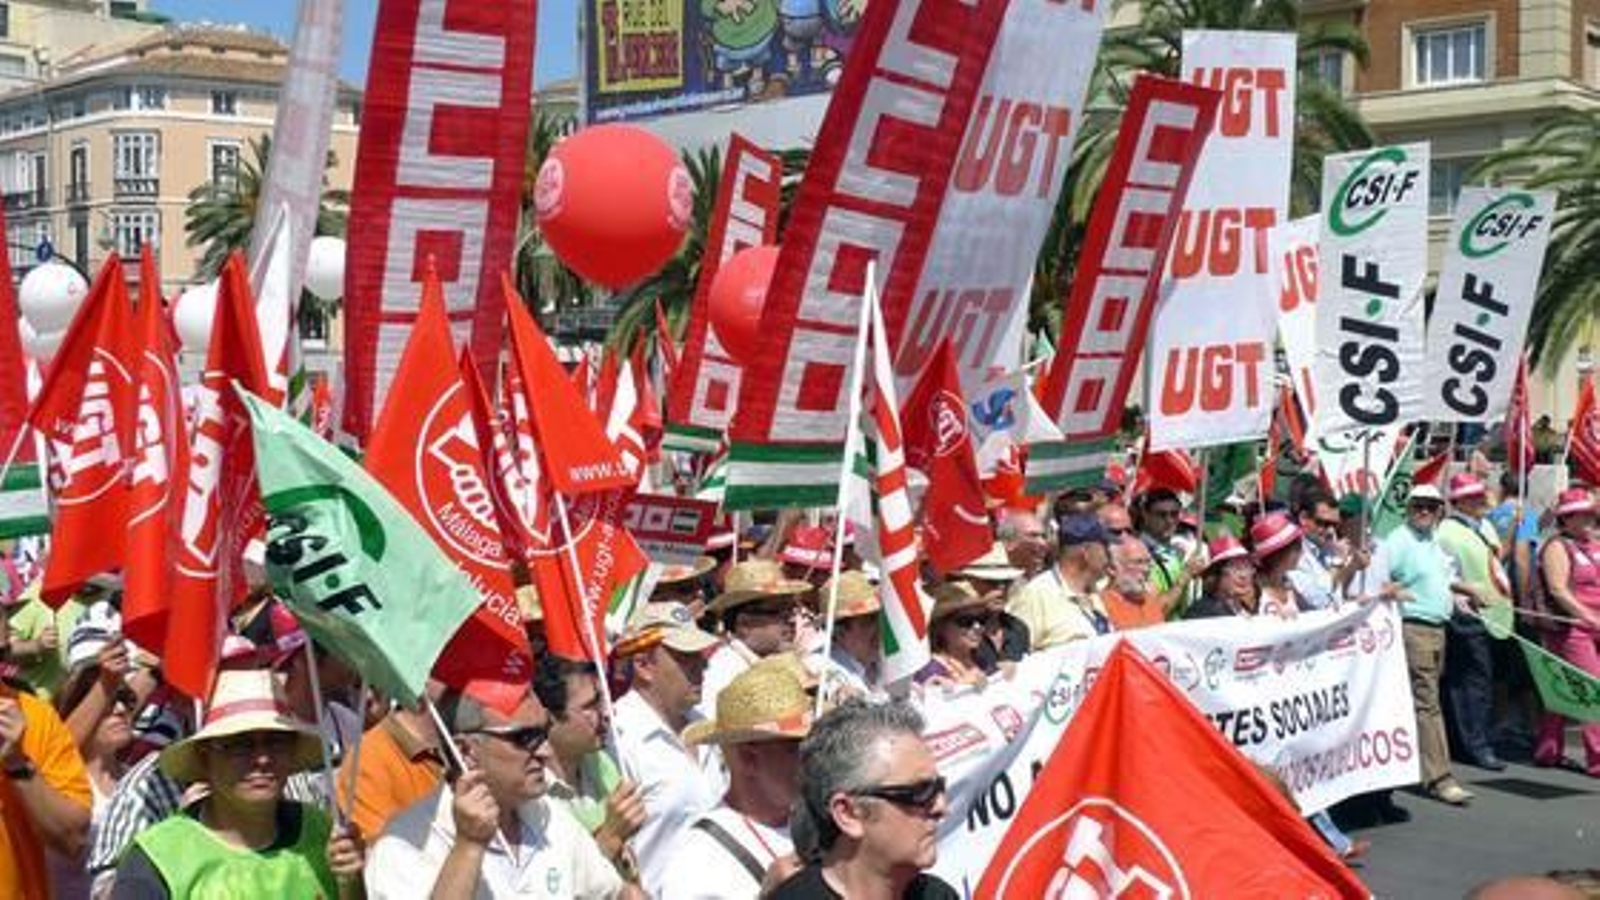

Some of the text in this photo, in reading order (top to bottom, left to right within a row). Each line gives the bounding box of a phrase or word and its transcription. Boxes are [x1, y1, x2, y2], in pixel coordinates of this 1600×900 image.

[954, 95, 1072, 199] UGT
[1060, 98, 1199, 432] CCOO
[1171, 208, 1276, 279] UGT
[1160, 342, 1265, 416] UGT
[966, 771, 1016, 832] NO
[1270, 681, 1350, 740] SOCIALES
